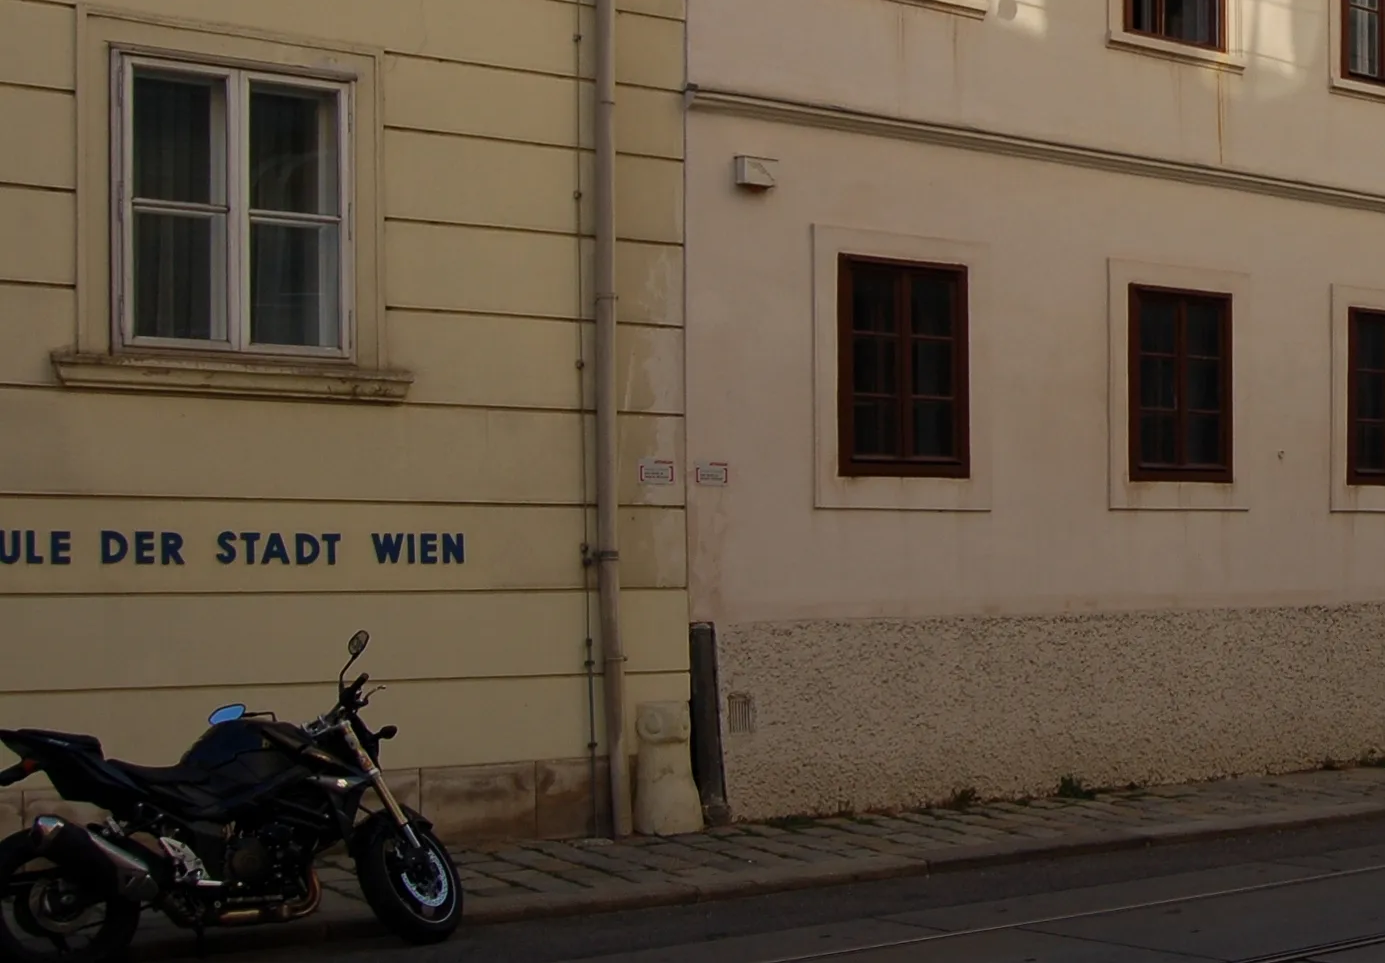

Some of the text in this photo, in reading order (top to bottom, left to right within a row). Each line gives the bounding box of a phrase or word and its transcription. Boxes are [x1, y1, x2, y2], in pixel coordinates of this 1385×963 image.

[0, 529, 465, 566] ULE DER STADT WIEN
